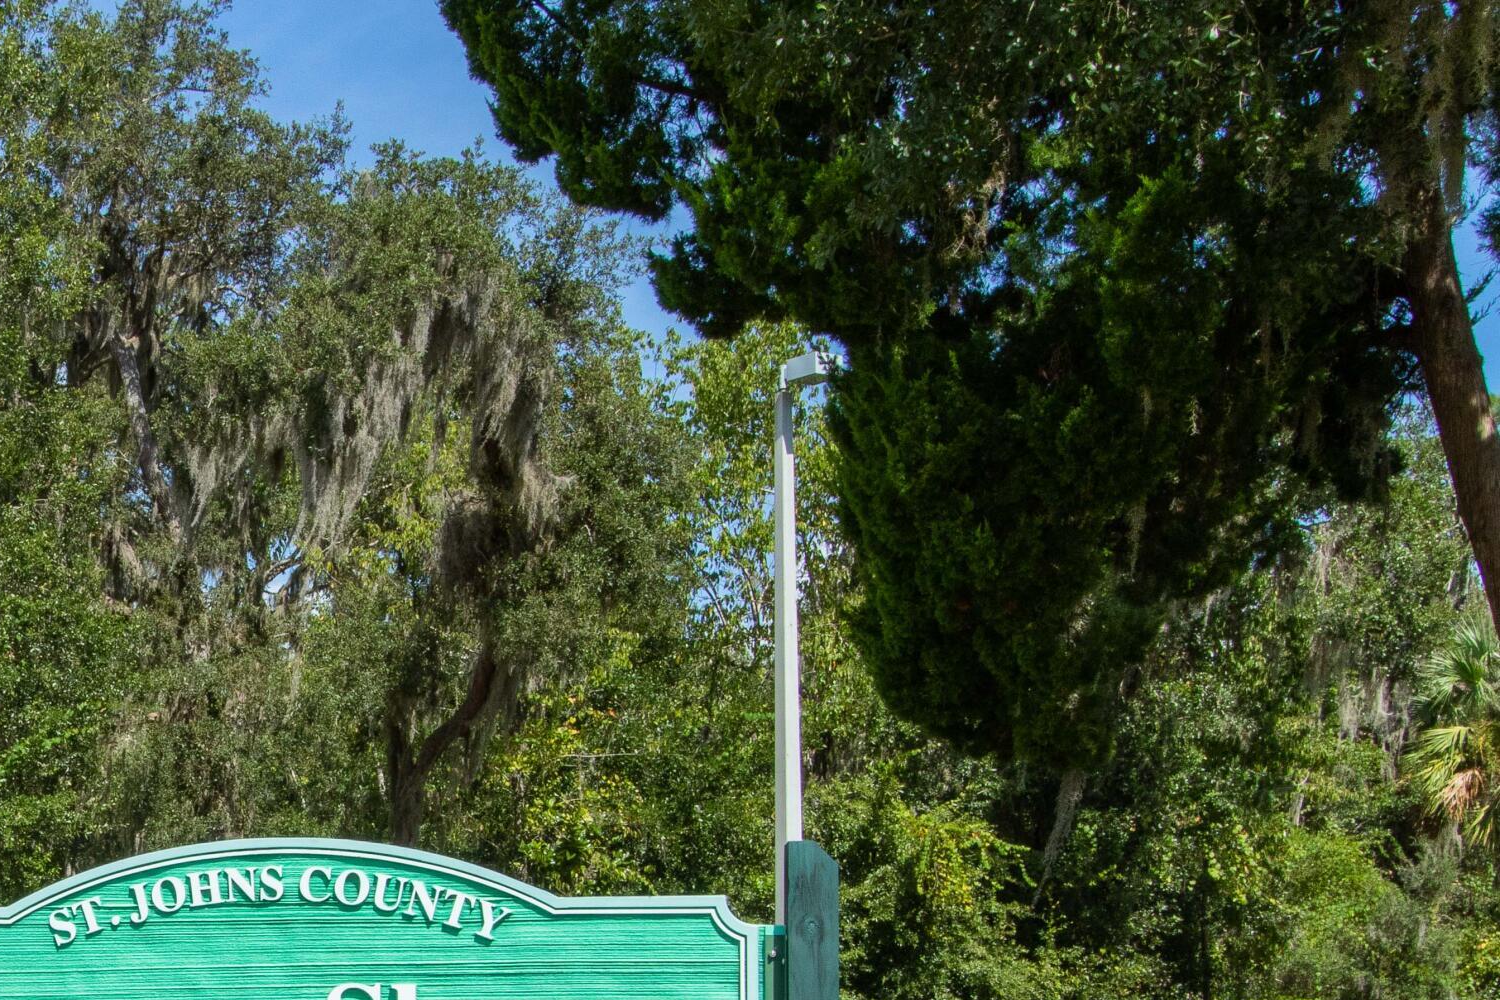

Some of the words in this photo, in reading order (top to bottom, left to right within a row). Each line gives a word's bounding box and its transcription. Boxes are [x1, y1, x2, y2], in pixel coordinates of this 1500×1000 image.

[48, 896, 121, 947] ST.
[128, 865, 285, 925] JOHNS
[299, 866, 513, 942] COUNTY
